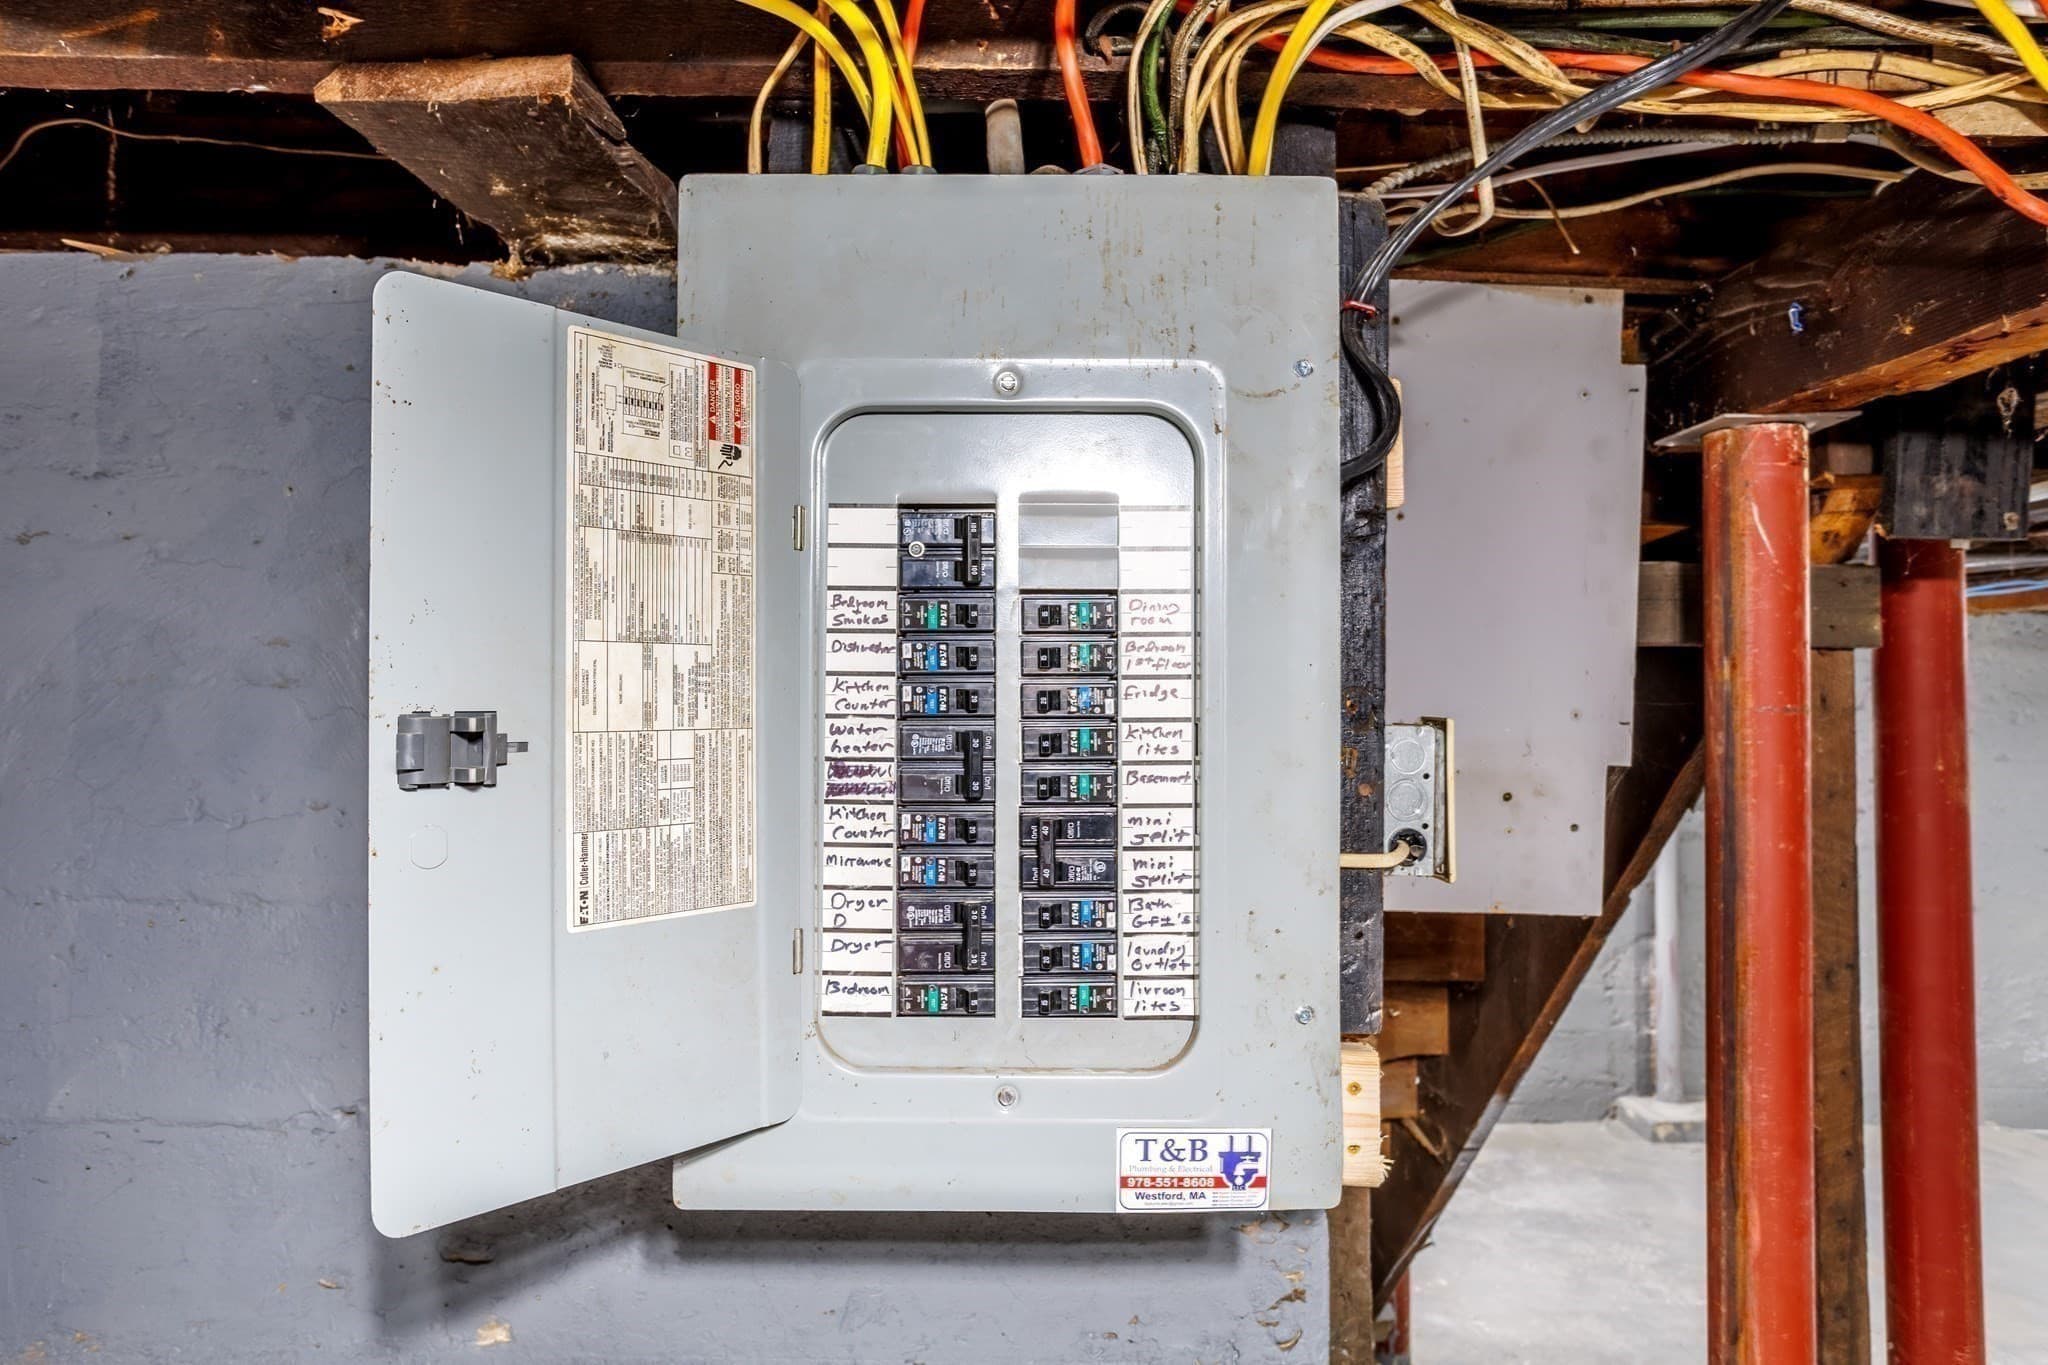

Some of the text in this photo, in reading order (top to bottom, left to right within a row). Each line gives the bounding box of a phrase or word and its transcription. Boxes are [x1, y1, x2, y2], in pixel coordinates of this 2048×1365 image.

[970, 695, 978, 703] 20
[972, 738, 979, 748] 30
[972, 782, 979, 790] 30
[1042, 826, 1048, 836] 40
[579, 832, 589, 884] Cutler-Hammer
[1042, 869, 1049, 878] 40
[971, 910, 978, 920] 30
[831, 939, 896, 954] Dryer
[971, 954, 978, 964] 30
[1130, 1164, 1166, 1173] Plumbing
[1178, 1164, 1213, 1172] Electrical
[1127, 1177, 1215, 1188] 978-551-8608
[1135, 1191, 1186, 1200] Westford,
[1189, 1191, 1206, 1200] MA
